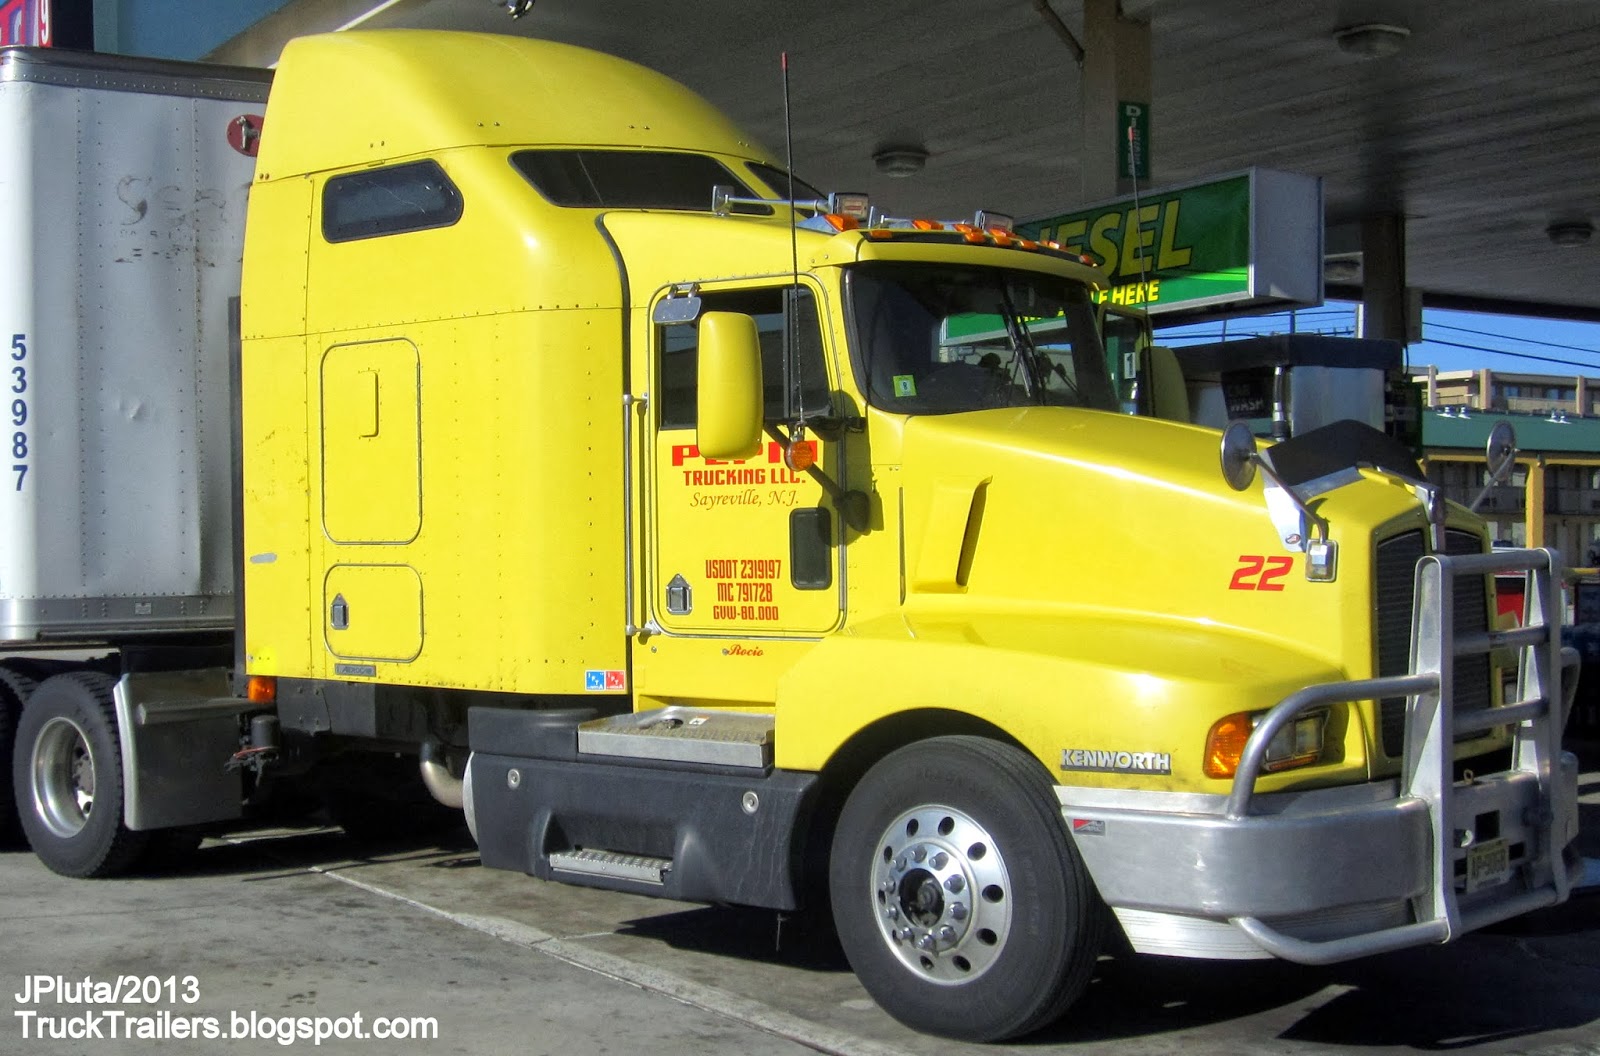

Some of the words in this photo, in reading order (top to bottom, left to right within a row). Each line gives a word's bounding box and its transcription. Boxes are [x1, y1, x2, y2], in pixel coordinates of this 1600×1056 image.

[1112, 279, 1160, 305] HERE
[11, 334, 28, 491] 53987
[683, 469, 765, 486] TRUCKING
[771, 468, 806, 484] LLC.
[690, 489, 762, 510] Sayreville,
[767, 490, 799, 506] N.J.
[706, 560, 738, 578] USDOT
[741, 560, 781, 579] 2319197
[1229, 555, 1294, 591] 22
[717, 583, 734, 602] MC
[736, 583, 772, 602] 791728
[713, 606, 779, 620] GVW-80.000
[728, 644, 764, 656] Rocio
[1062, 749, 1171, 771] KENWORTH
